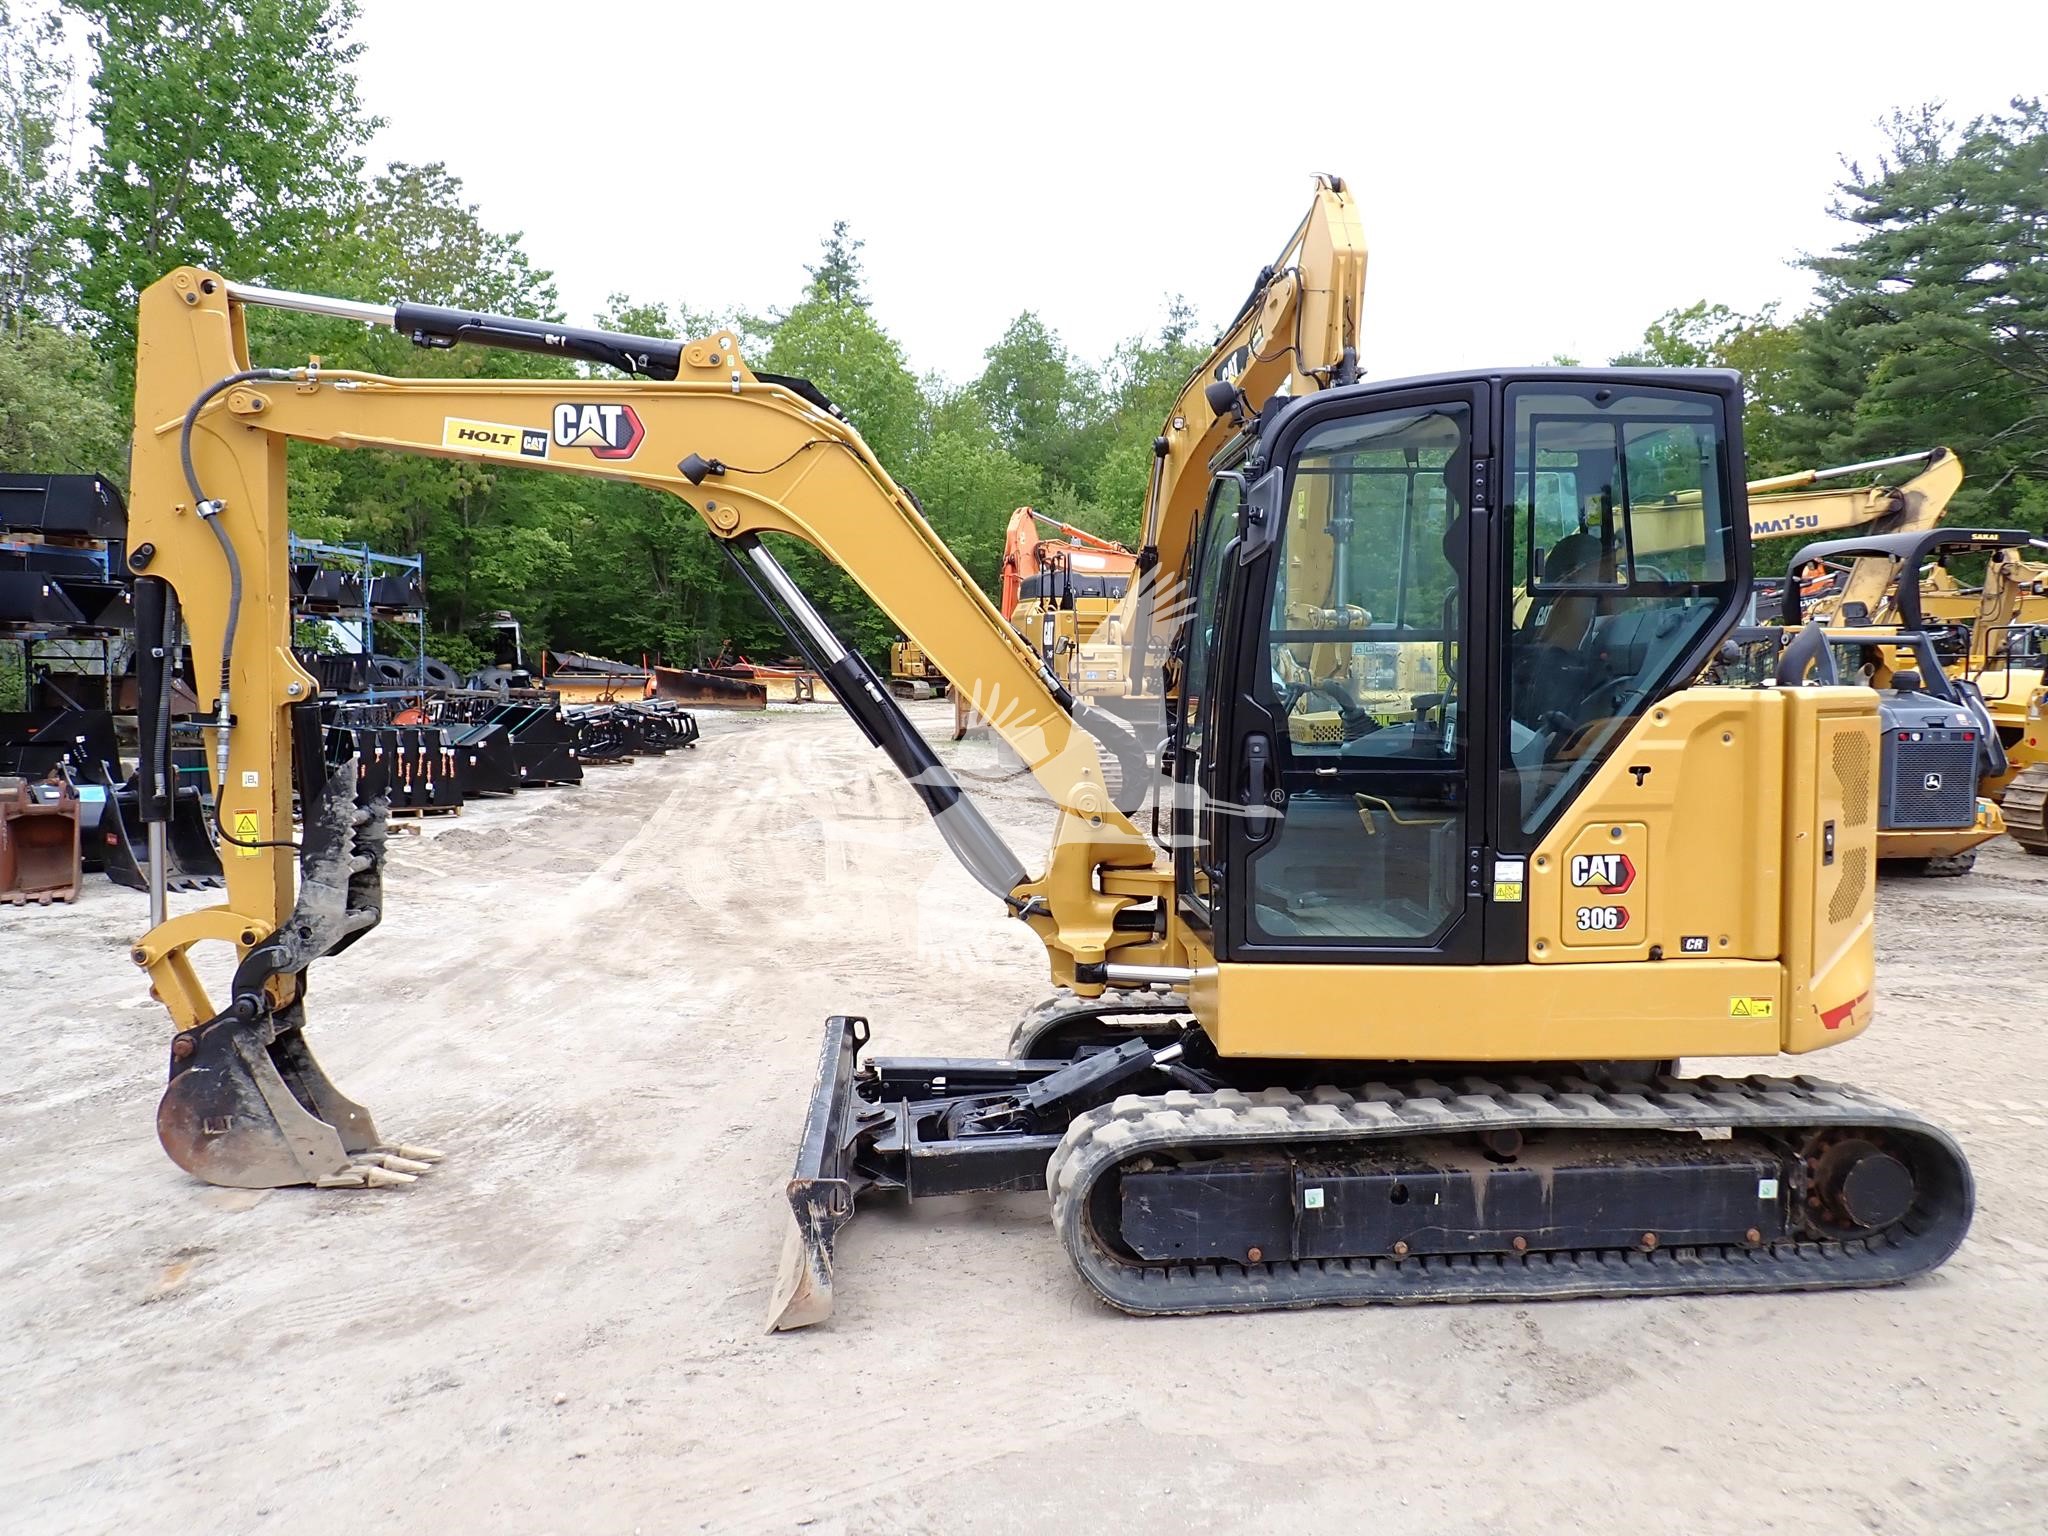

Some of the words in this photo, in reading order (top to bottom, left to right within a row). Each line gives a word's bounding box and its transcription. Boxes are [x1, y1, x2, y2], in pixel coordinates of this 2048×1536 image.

[554, 404, 622, 447] CAT
[458, 428, 516, 446] HOLT
[522, 436, 546, 452] CAT
[1751, 514, 1819, 535] MATSU
[1970, 533, 1999, 541] SAKAI
[1571, 855, 1621, 888] CAT
[1577, 906, 1618, 930] 306
[1685, 938, 1703, 950] CR
